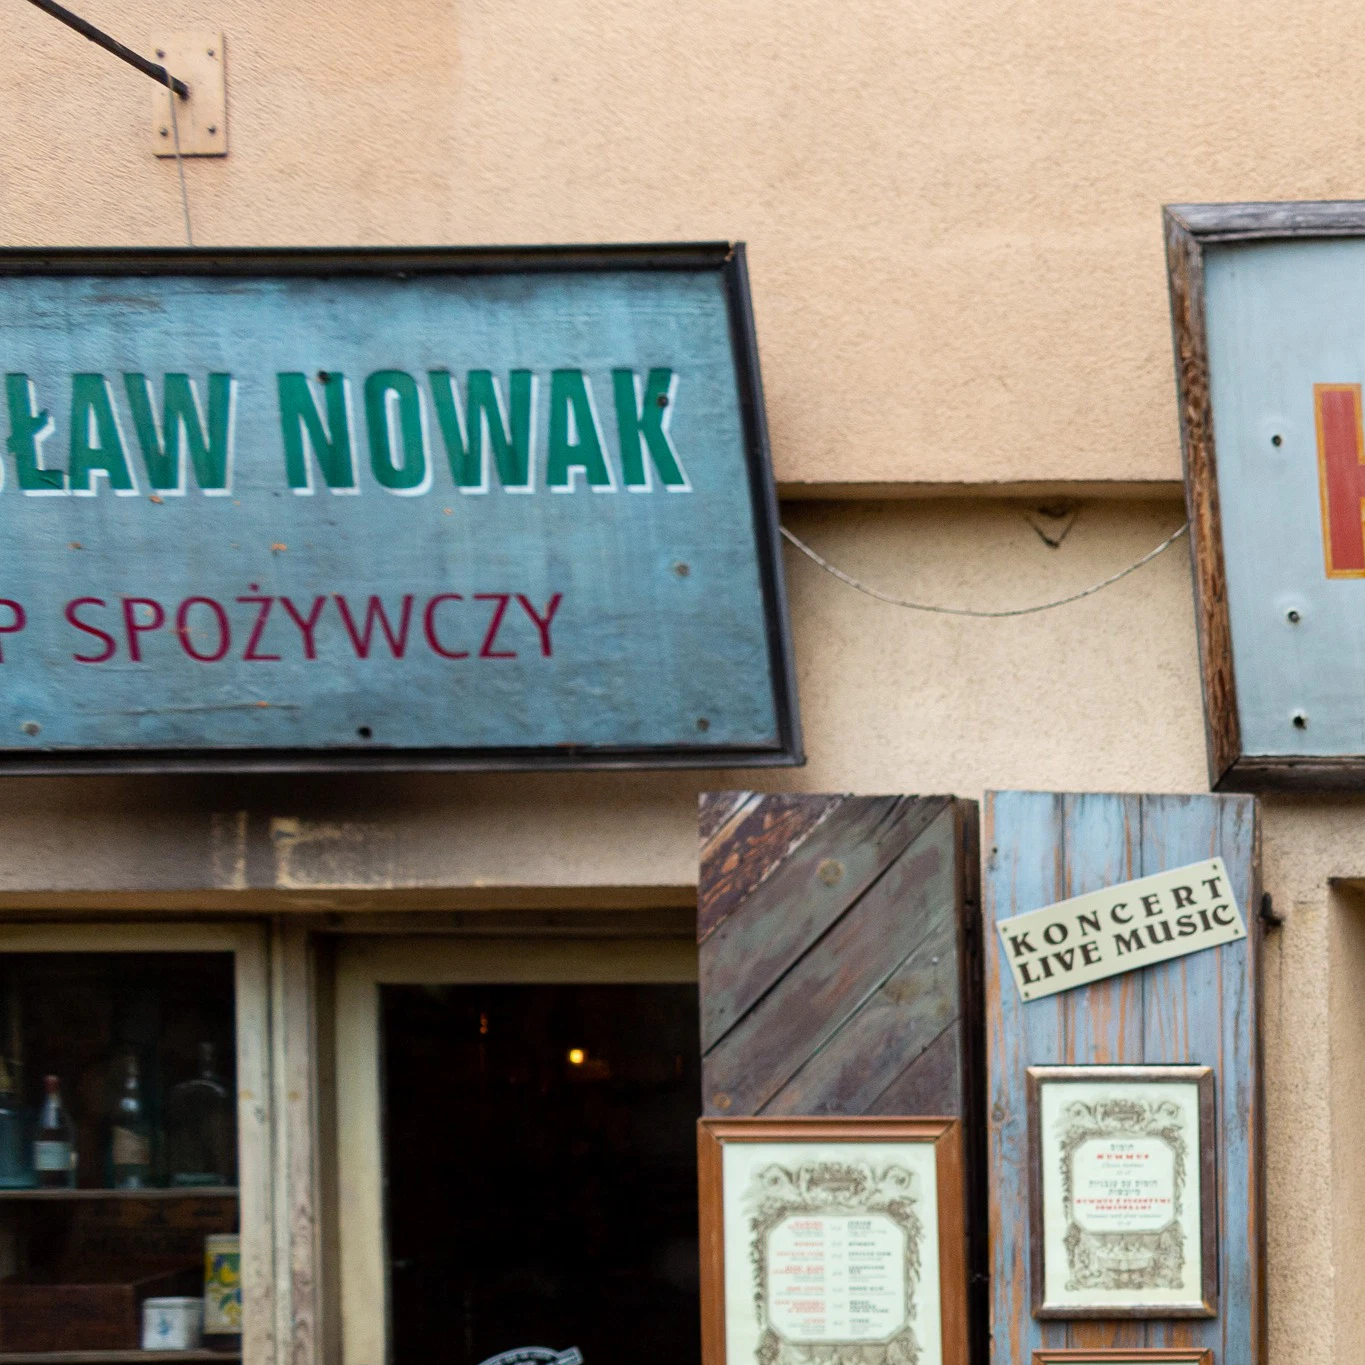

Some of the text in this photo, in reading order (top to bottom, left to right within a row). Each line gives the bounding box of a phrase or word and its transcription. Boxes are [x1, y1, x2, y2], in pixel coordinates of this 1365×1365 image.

[5, 367, 693, 497] ŁAW NOWAK
[65, 584, 563, 663] SPOŻYWCZY
[1008, 876, 1222, 957] KONCERT
[1017, 904, 1235, 986] LIVE MUSIC
